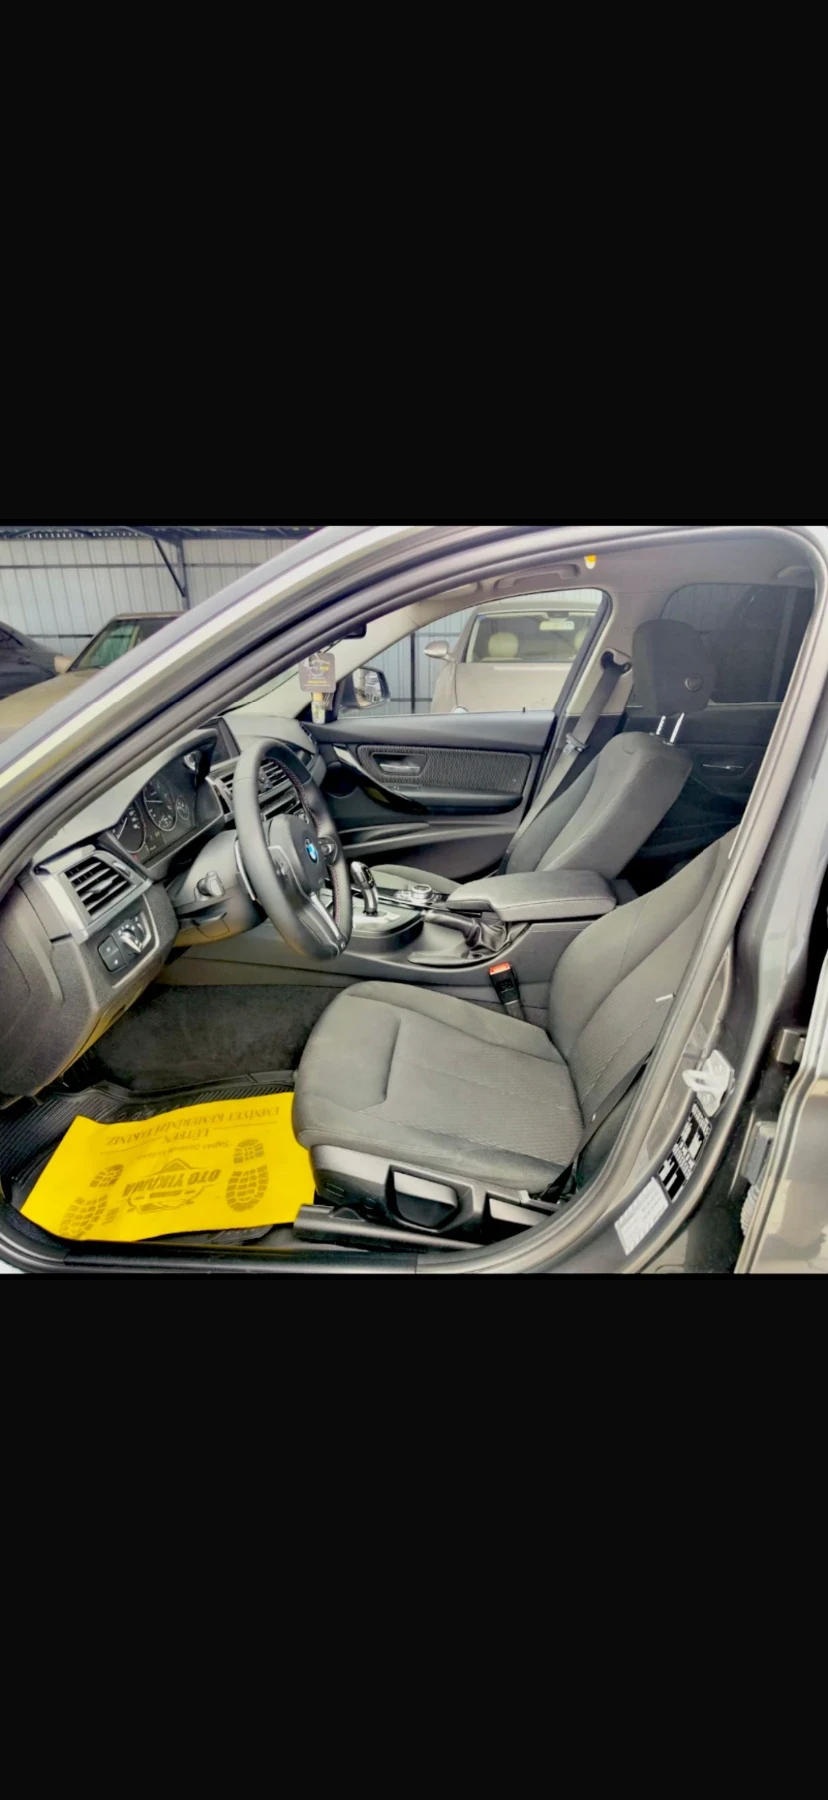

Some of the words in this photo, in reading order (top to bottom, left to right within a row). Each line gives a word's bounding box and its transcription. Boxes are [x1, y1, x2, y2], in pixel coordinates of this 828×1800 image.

[227, 1106, 279, 1120] EMNİYET
[122, 1173, 185, 1197] YIKAMA
[187, 1169, 222, 1185] OTO
